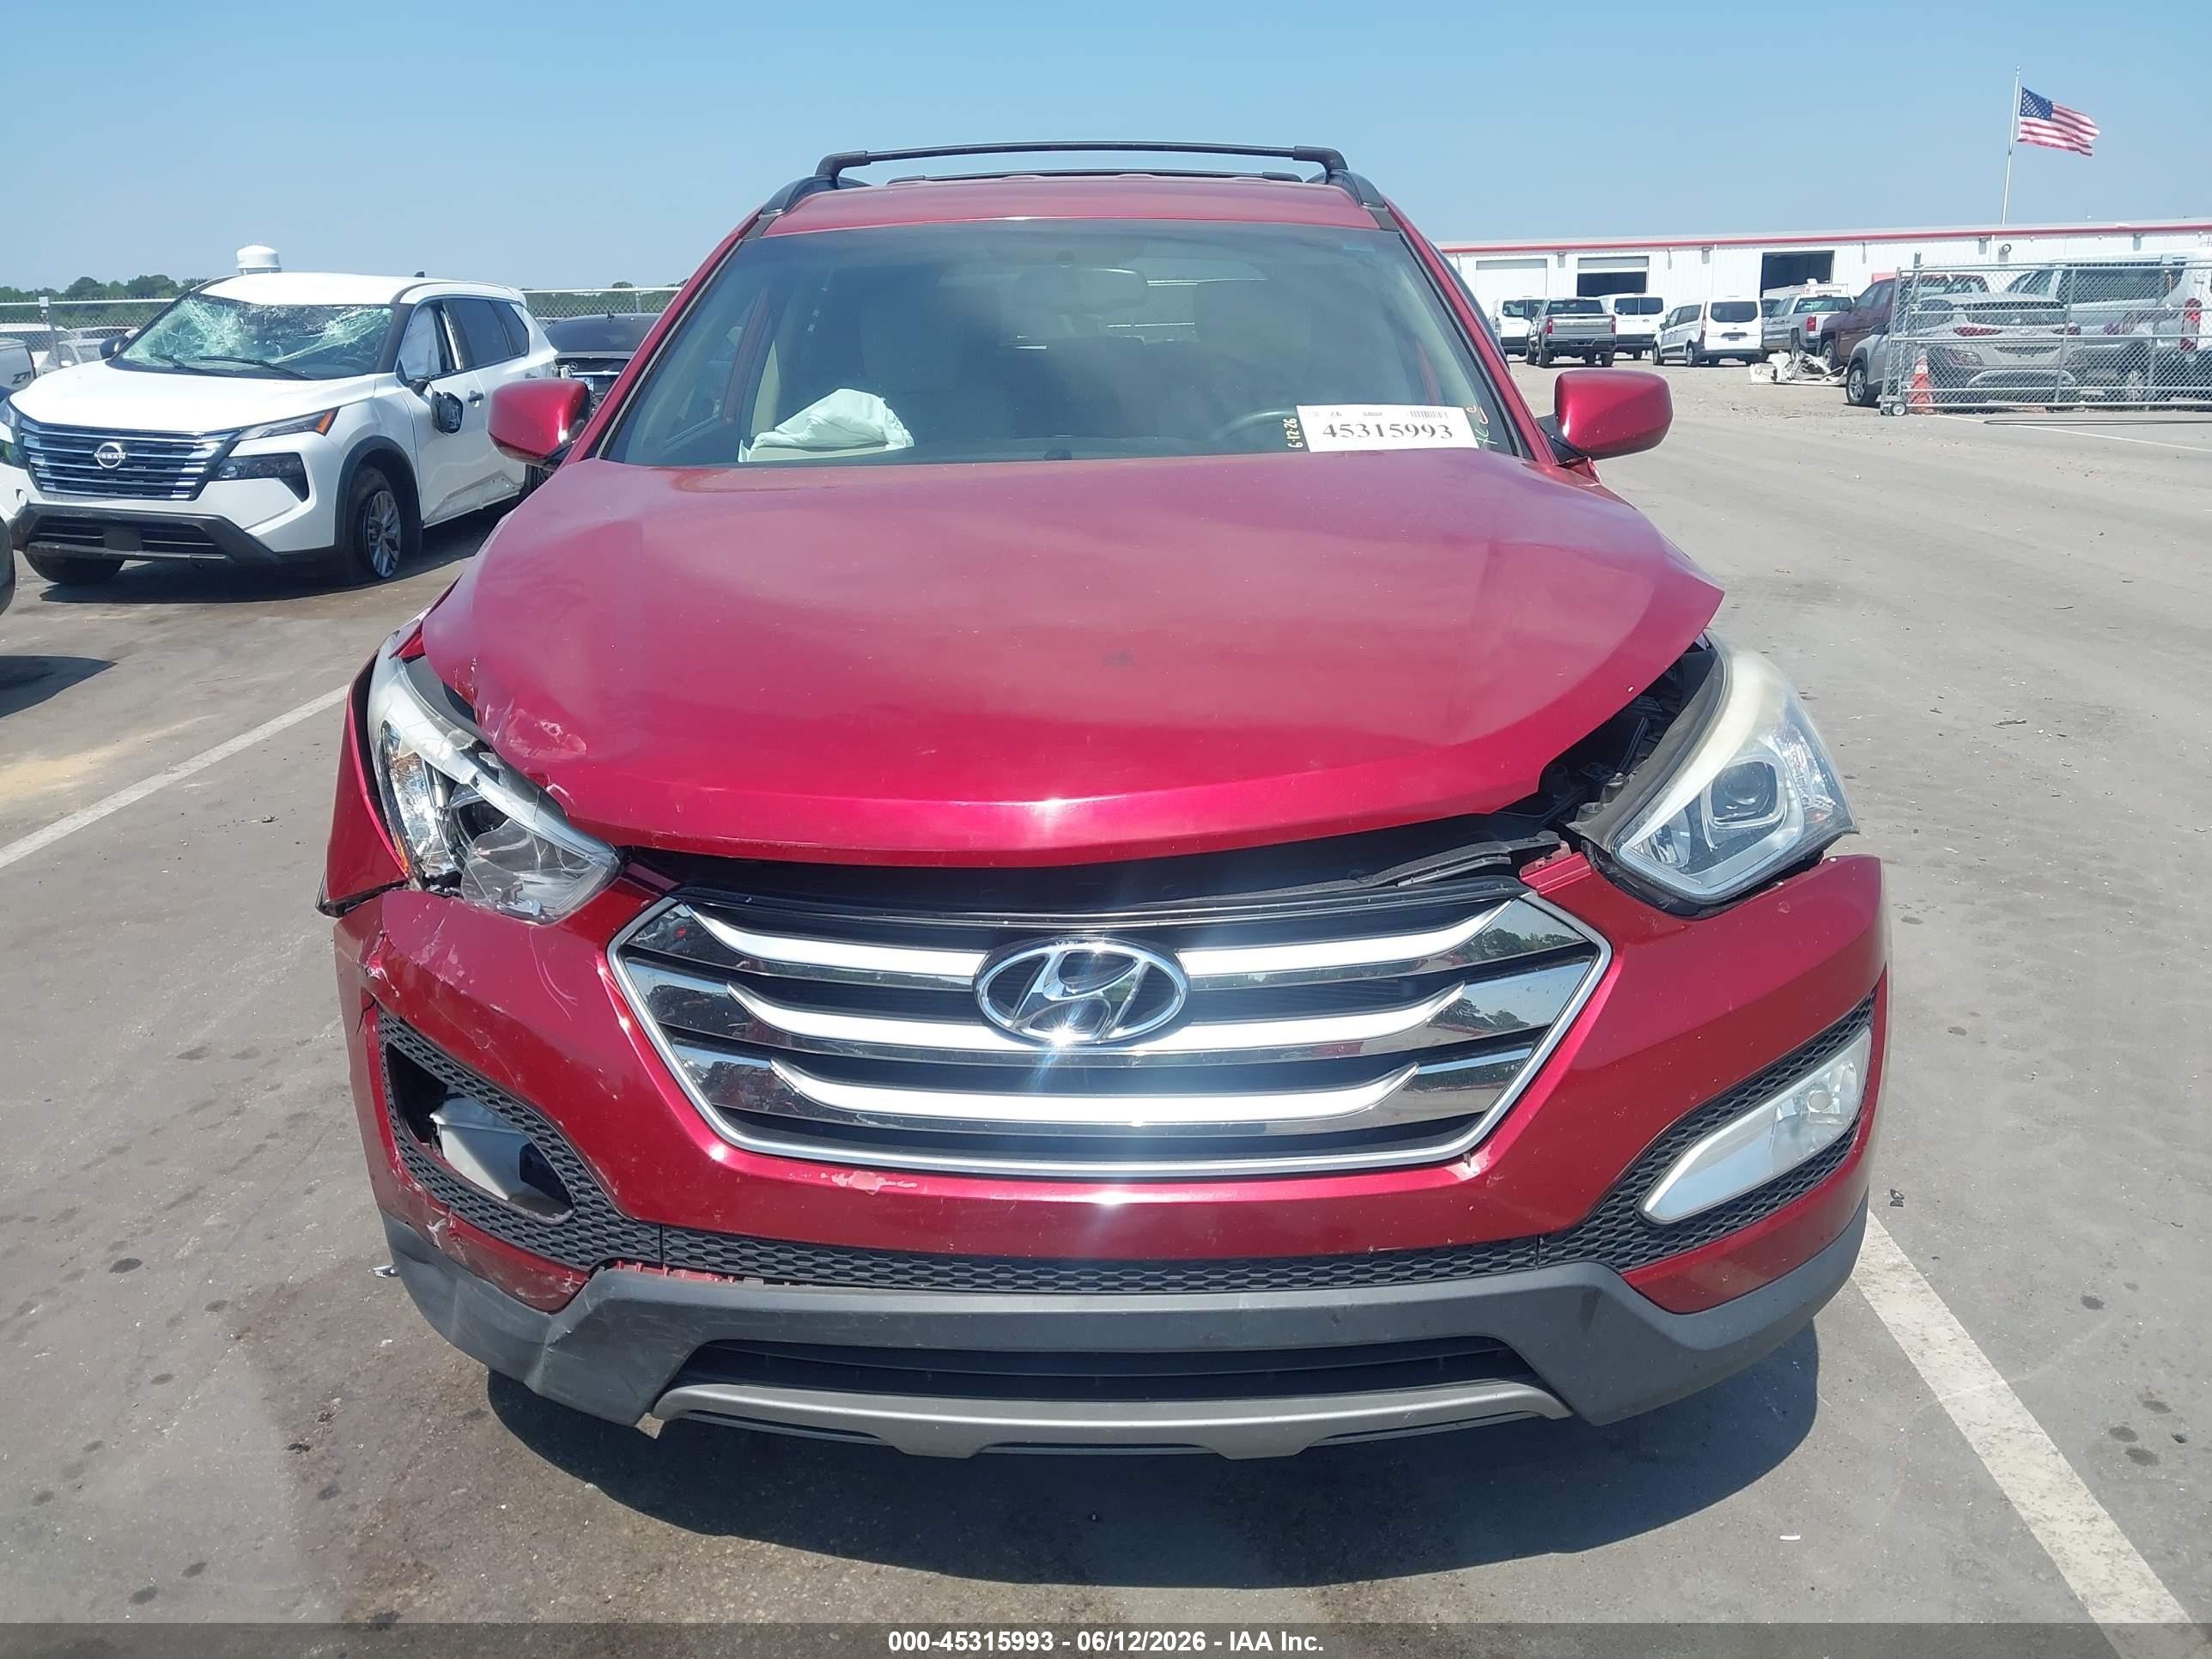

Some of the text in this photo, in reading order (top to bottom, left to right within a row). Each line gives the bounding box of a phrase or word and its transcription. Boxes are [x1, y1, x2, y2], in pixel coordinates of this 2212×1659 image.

[11, 370, 32, 386] Z71
[1322, 423, 1453, 440] 45315993
[94, 452, 126, 460] NISSAN
